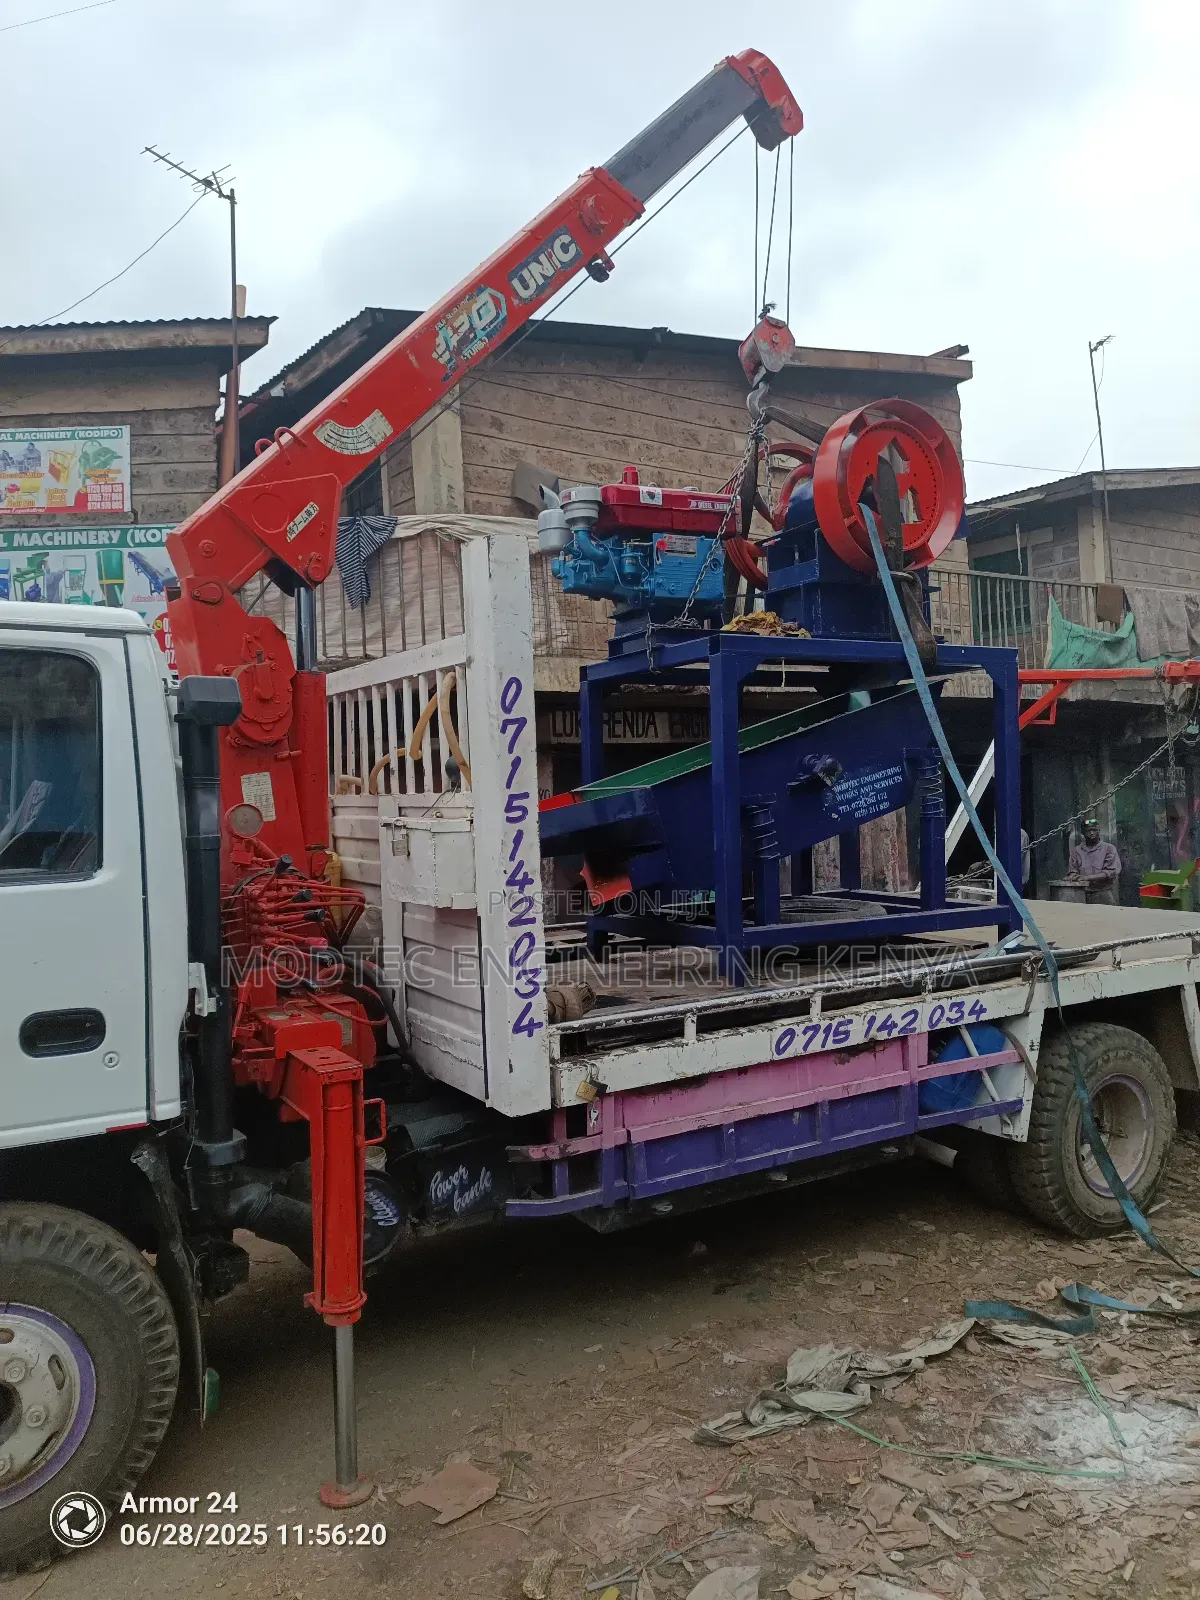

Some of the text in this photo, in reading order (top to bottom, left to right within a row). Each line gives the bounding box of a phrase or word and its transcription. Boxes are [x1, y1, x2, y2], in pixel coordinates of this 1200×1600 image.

[511, 234, 577, 298] UNIC
[15, 431, 72, 440] MACHINERY
[75, 429, 122, 439] (KODIPO)
[13, 530, 121, 546] MACHINERY
[860, 766, 902, 785] ENGINEERING
[860, 784, 873, 795] AND
[873, 775, 903, 790] SERVICES
[774, 999, 987, 1057] 0715 142 034
